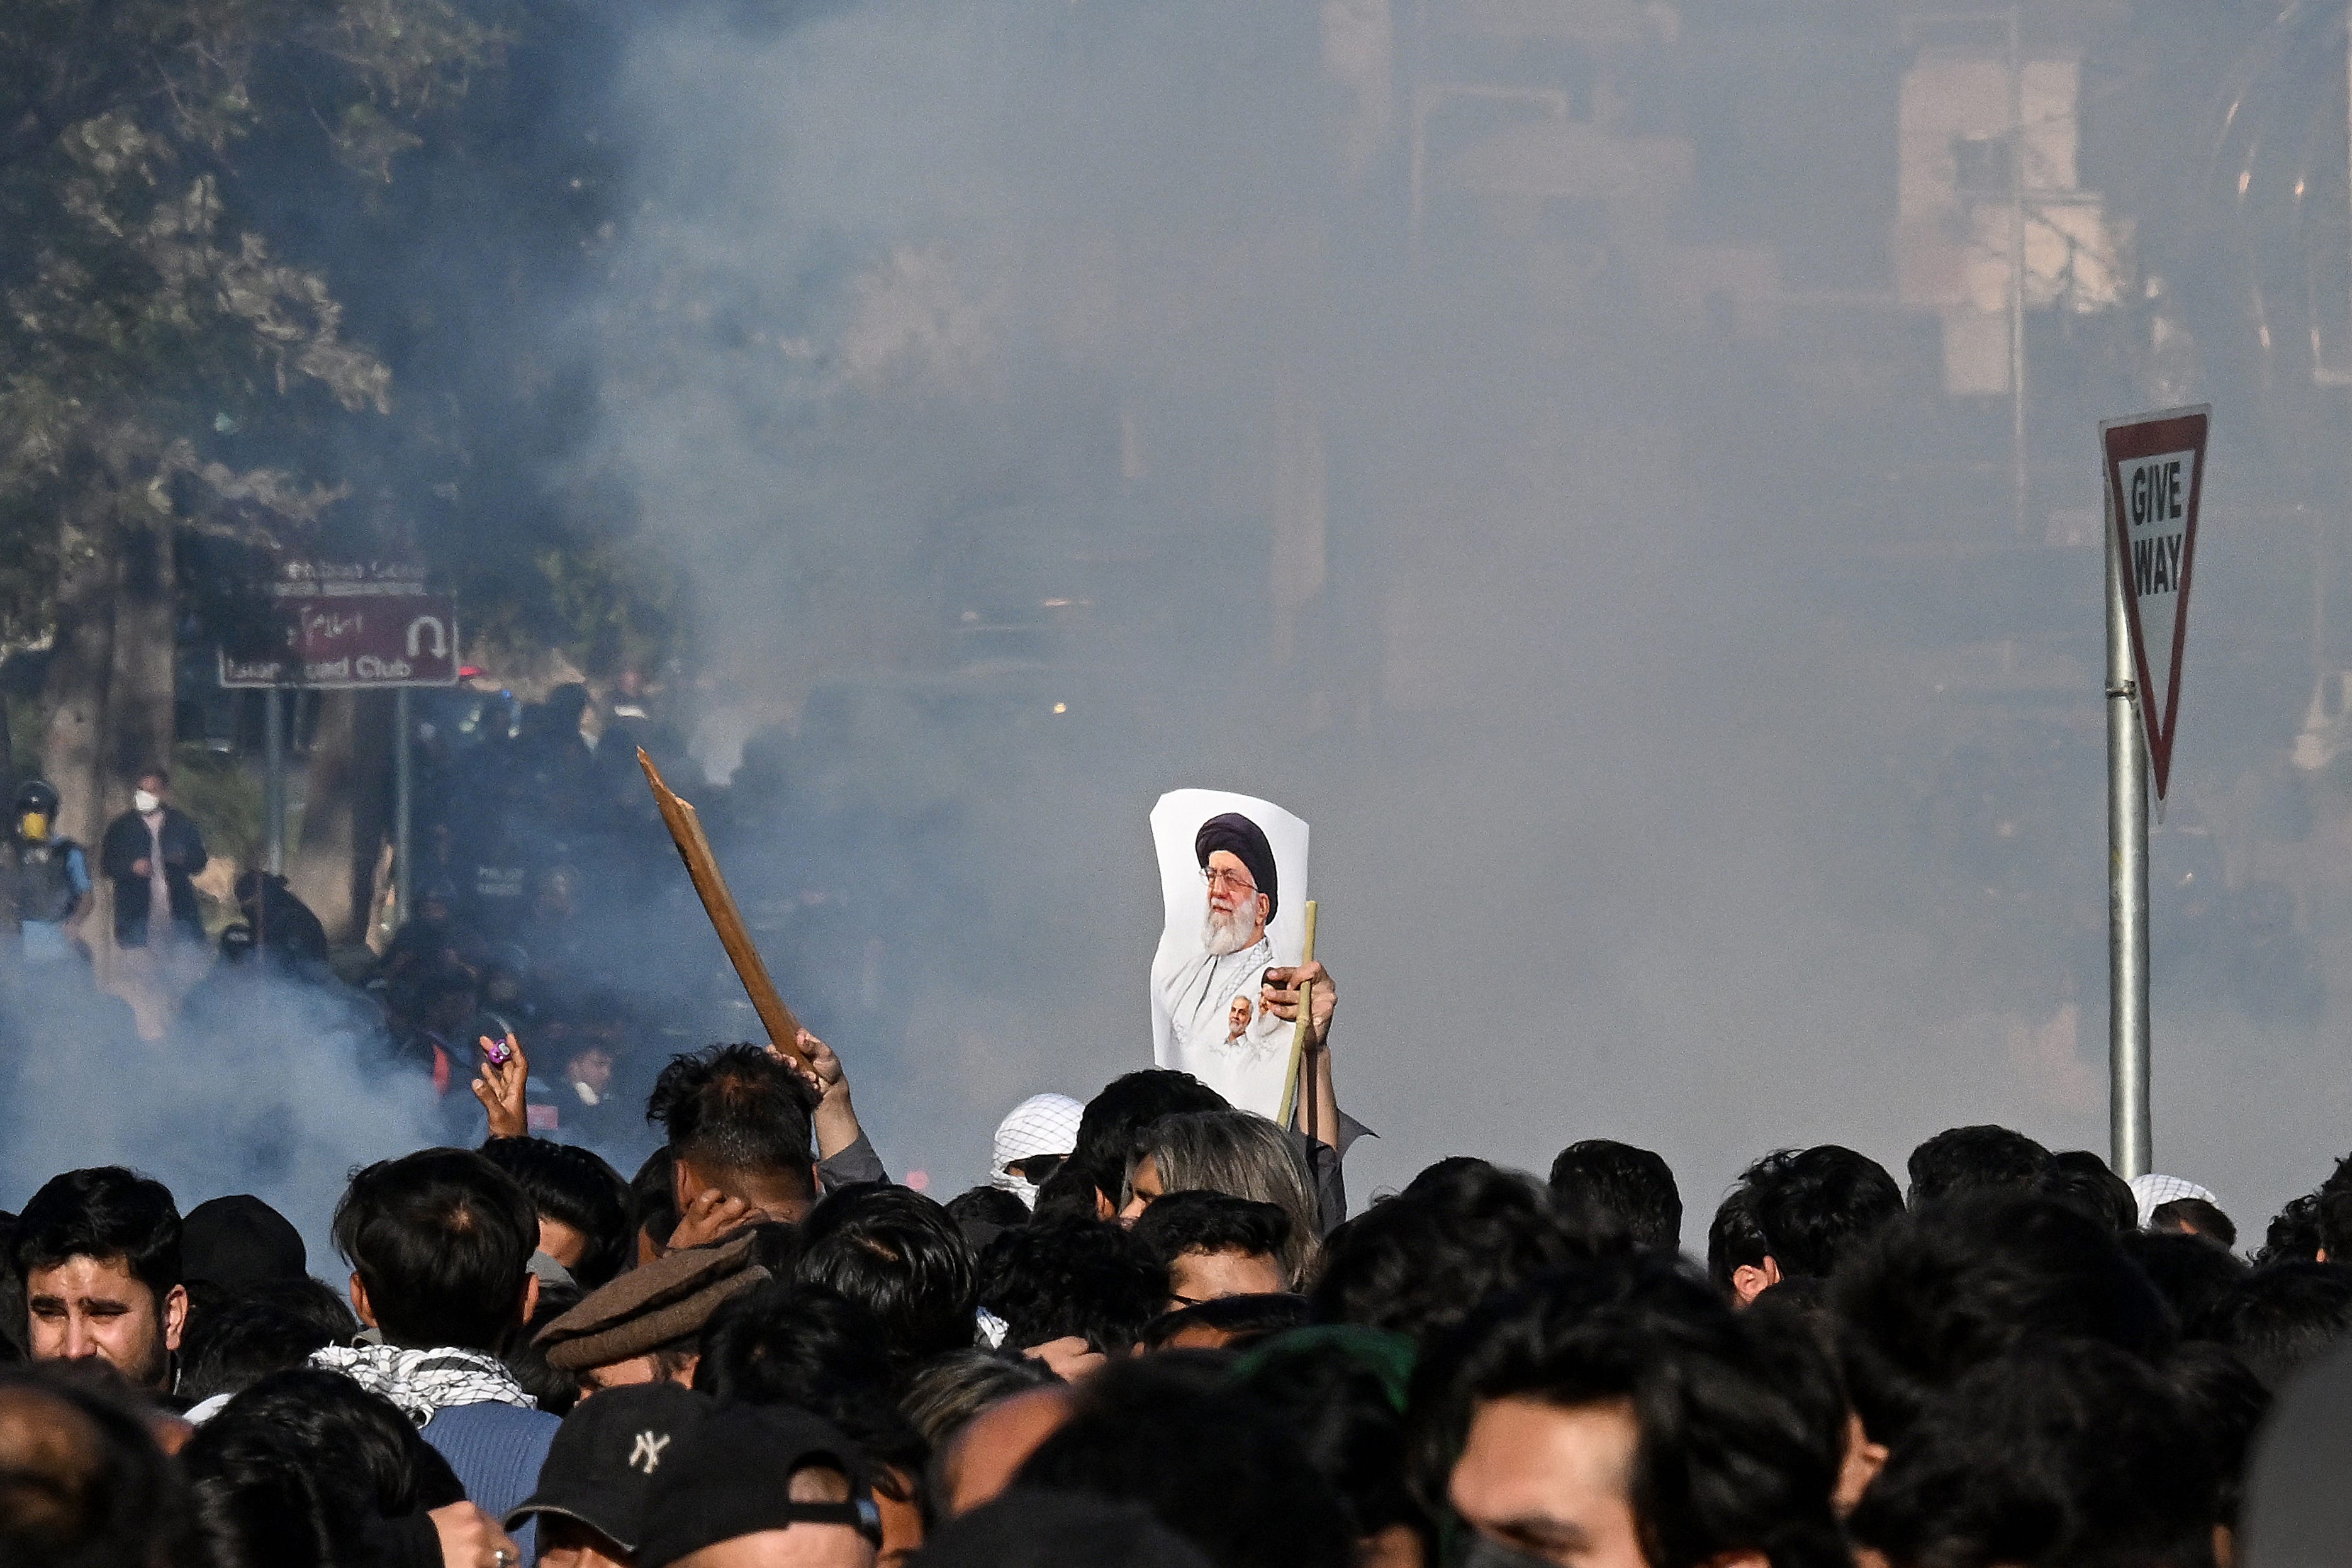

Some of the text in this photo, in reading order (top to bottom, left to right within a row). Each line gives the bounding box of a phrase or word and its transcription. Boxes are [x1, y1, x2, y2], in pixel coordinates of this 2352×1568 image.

[2132, 461, 2181, 525] GIVE
[2135, 534, 2181, 597] WAY
[629, 1430, 671, 1474] NY
